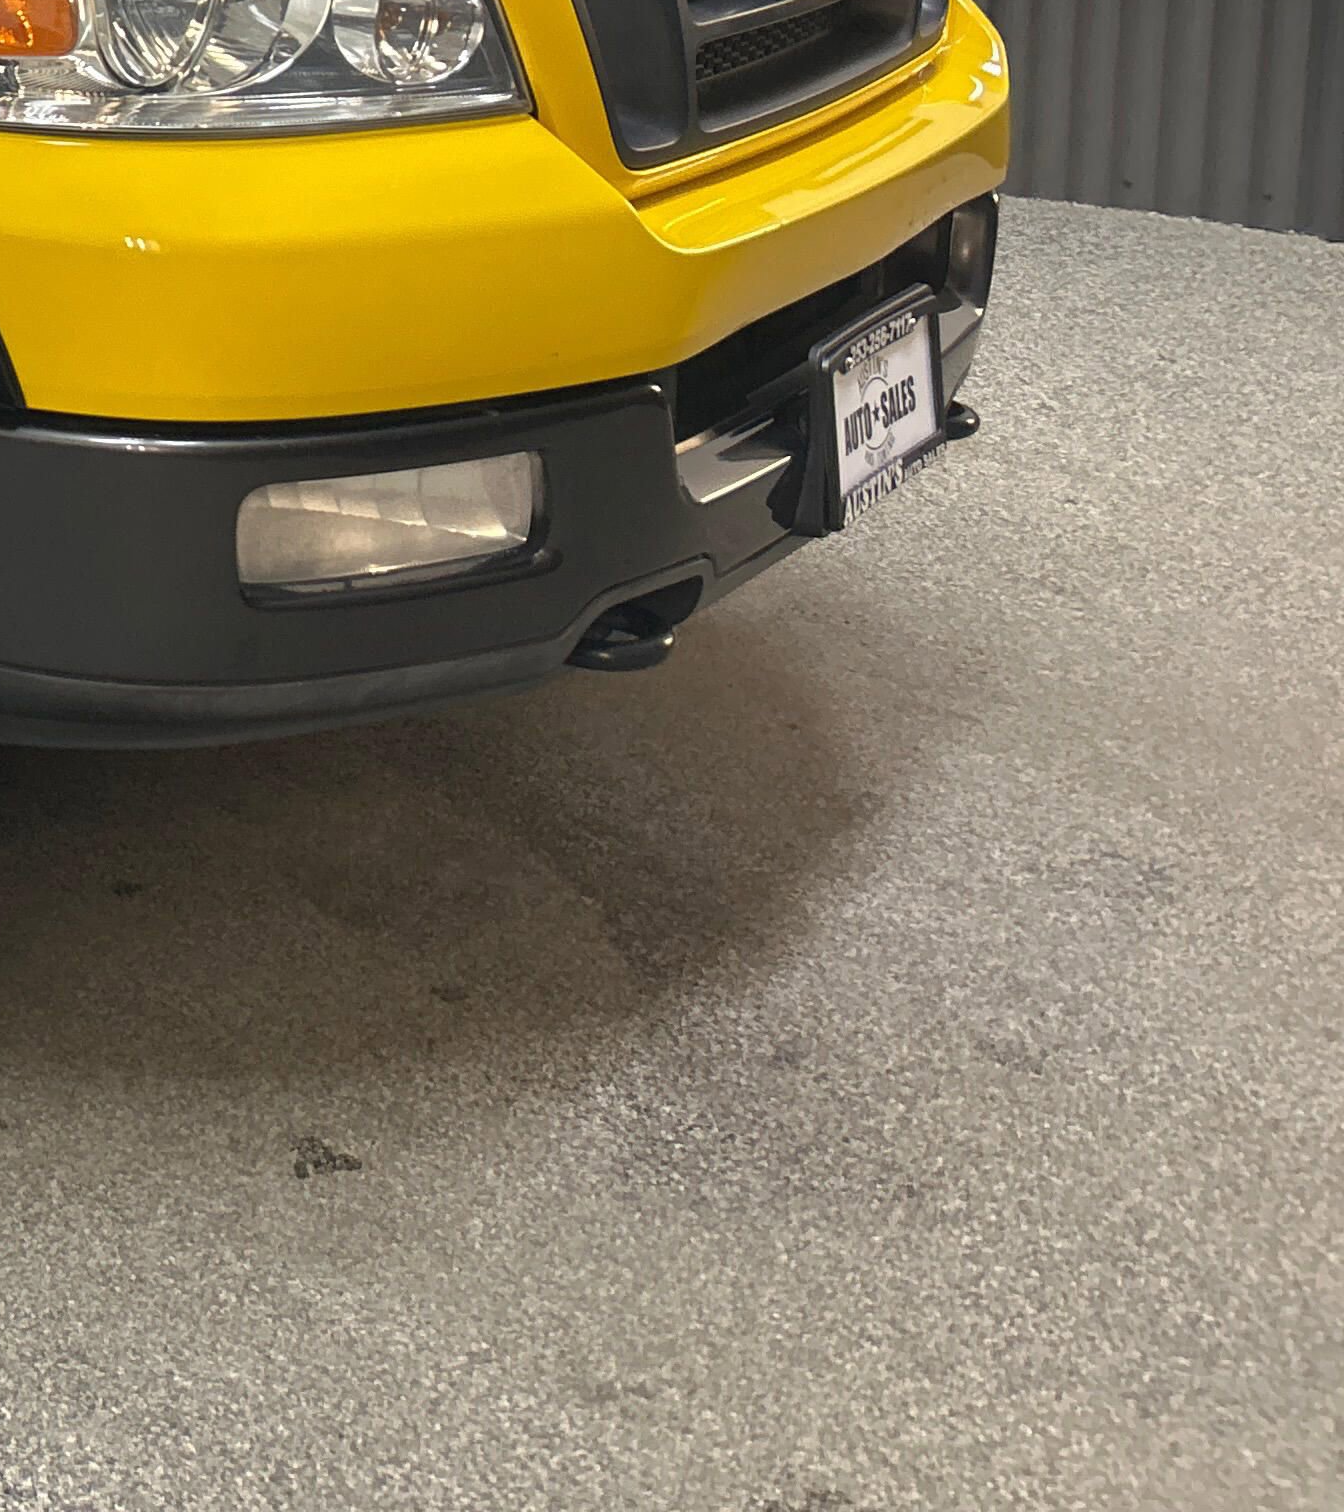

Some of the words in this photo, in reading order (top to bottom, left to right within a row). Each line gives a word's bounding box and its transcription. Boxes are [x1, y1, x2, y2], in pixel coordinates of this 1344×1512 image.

[845, 402, 872, 456] AUTO
[879, 375, 916, 428] SALES
[844, 458, 904, 528] AUSTIN'S
